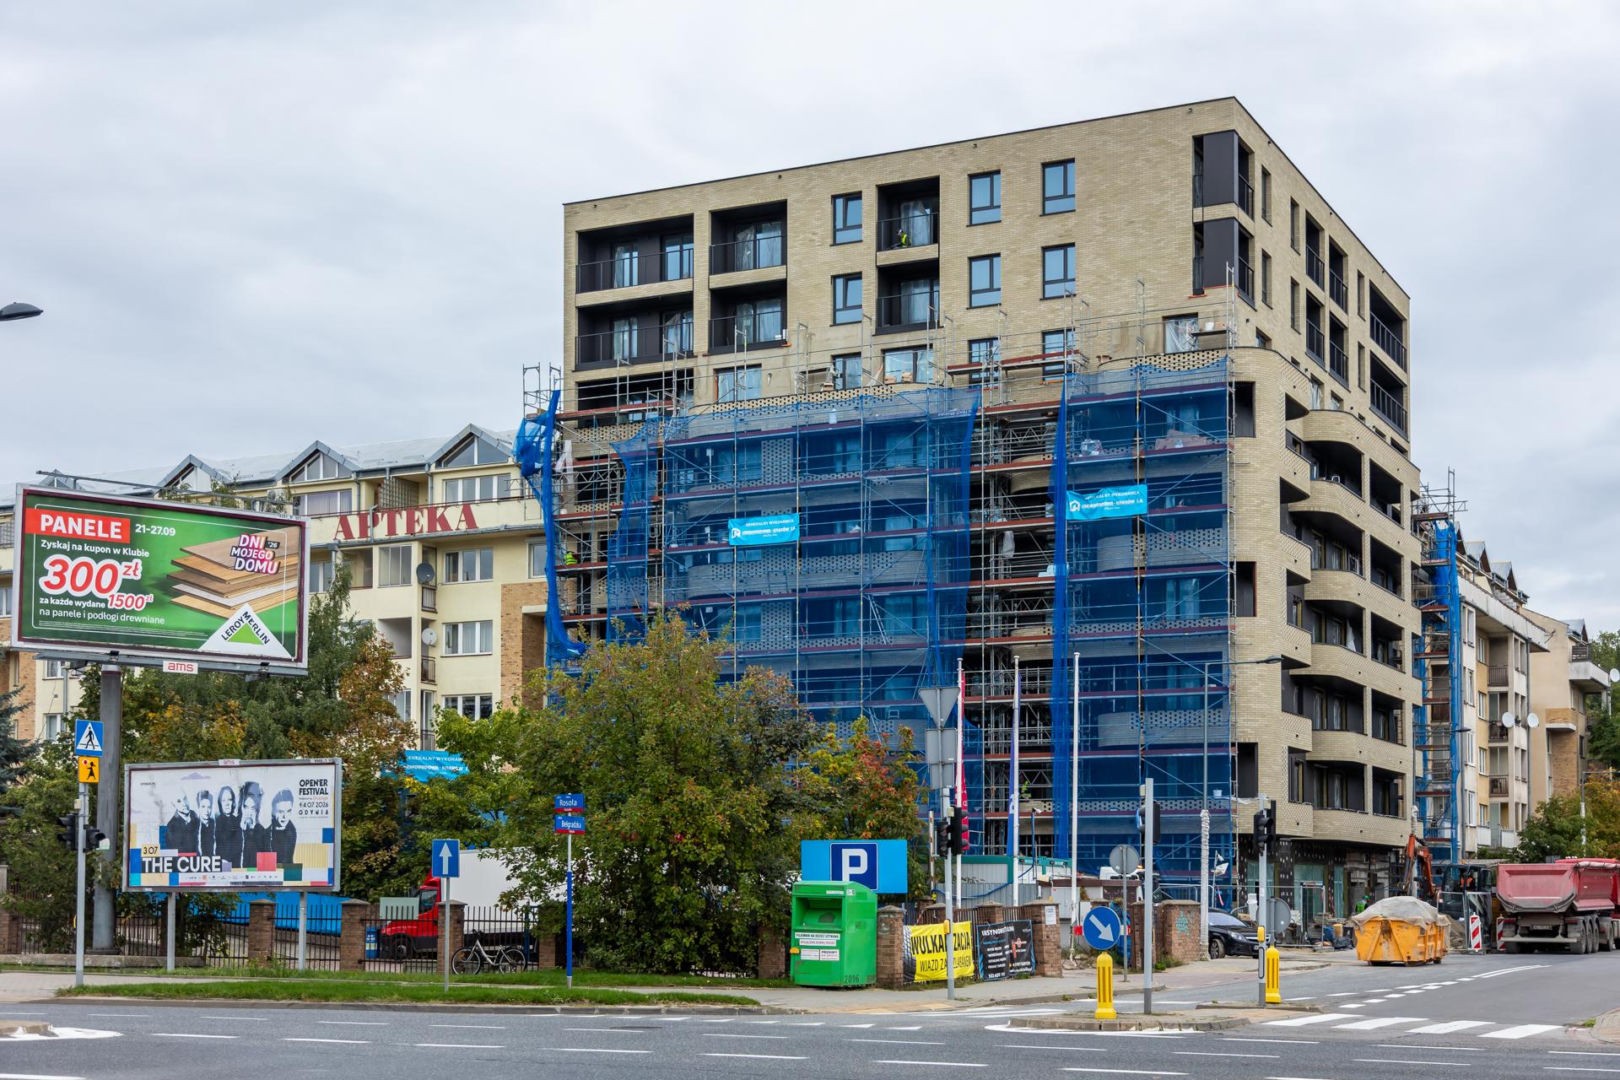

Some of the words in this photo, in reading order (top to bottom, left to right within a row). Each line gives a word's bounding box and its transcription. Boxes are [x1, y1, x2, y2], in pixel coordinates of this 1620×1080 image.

[40, 514, 122, 539] PANELE
[135, 523, 176, 536] 21-27.09
[333, 503, 479, 540] APTEKA
[41, 540, 71, 552] Zyskaj
[84, 543, 111, 555] kupon
[122, 547, 150, 557] Klubie
[240, 534, 266, 548] DNI
[231, 547, 274, 560] MOJEGO
[235, 558, 279, 574] DOMU
[43, 557, 119, 595] 300
[122, 561, 140, 577] zł
[50, 597, 74, 606] każde
[74, 599, 106, 609] wydane
[108, 594, 145, 609] 1500
[52, 610, 82, 618] panele
[87, 611, 119, 621] podłogi
[119, 613, 165, 625] drewniane
[221, 616, 246, 641] LEROY
[242, 611, 271, 645] MERLIN
[167, 662, 194, 673] ams
[298, 787, 328, 795] FESTIVAL
[142, 857, 173, 873] THE
[176, 855, 222, 872] CURE
[841, 848, 868, 882] P
[911, 931, 970, 955] WULKAZACJA
